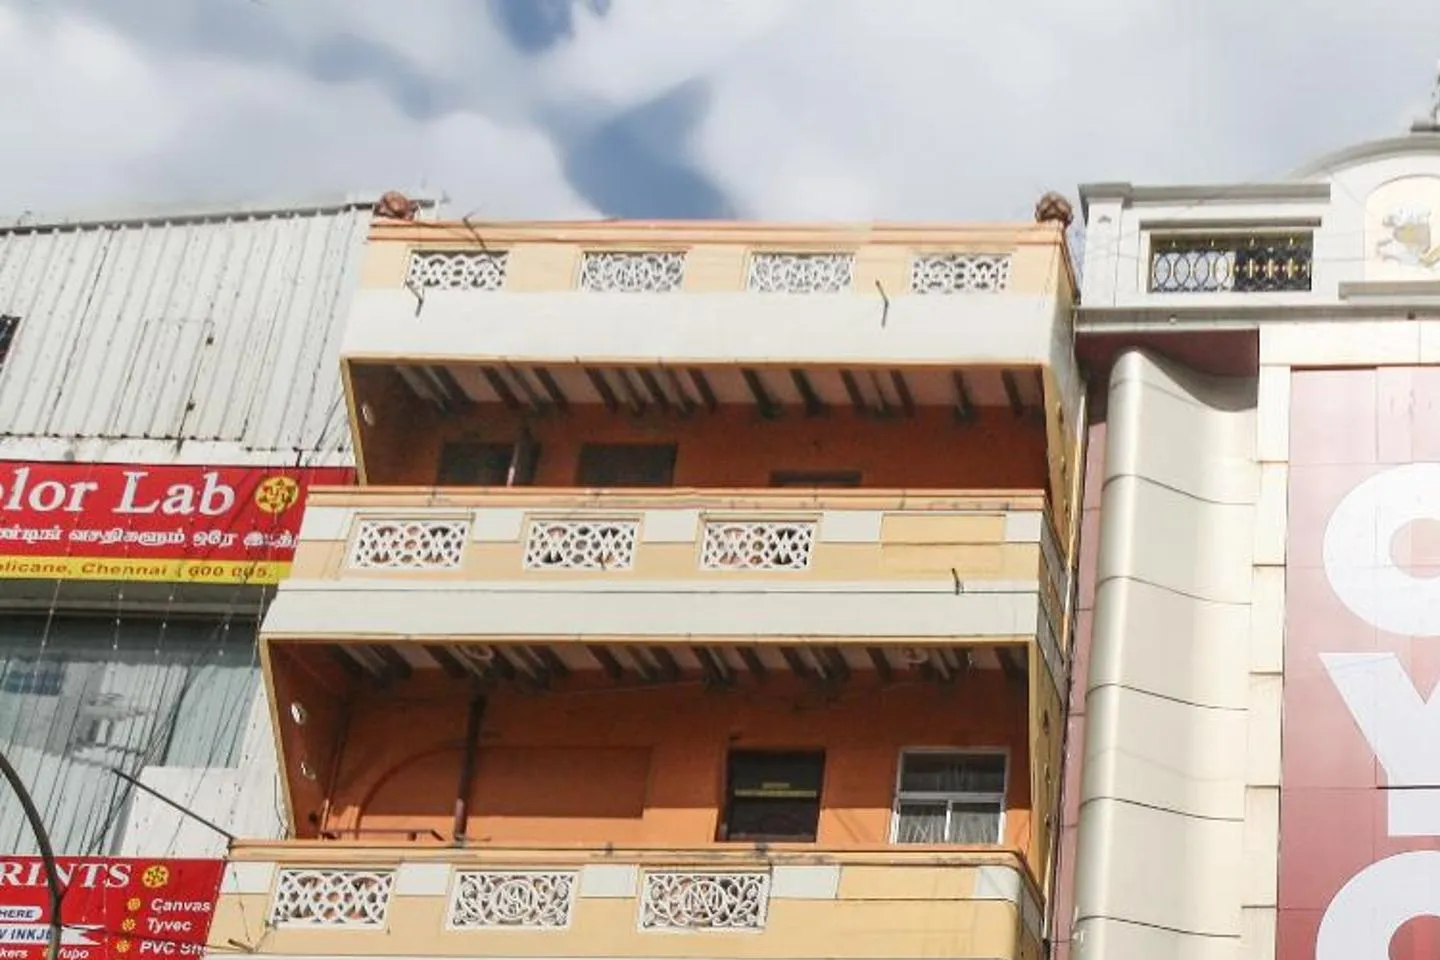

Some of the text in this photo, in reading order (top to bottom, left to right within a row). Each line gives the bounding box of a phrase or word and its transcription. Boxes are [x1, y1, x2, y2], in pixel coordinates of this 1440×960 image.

[0, 466, 235, 516] lor Lab
[81, 562, 168, 577] Chennai
[151, 898, 211, 912] Canvas
[147, 917, 192, 934] Tyvec
[139, 941, 176, 954] PVC
